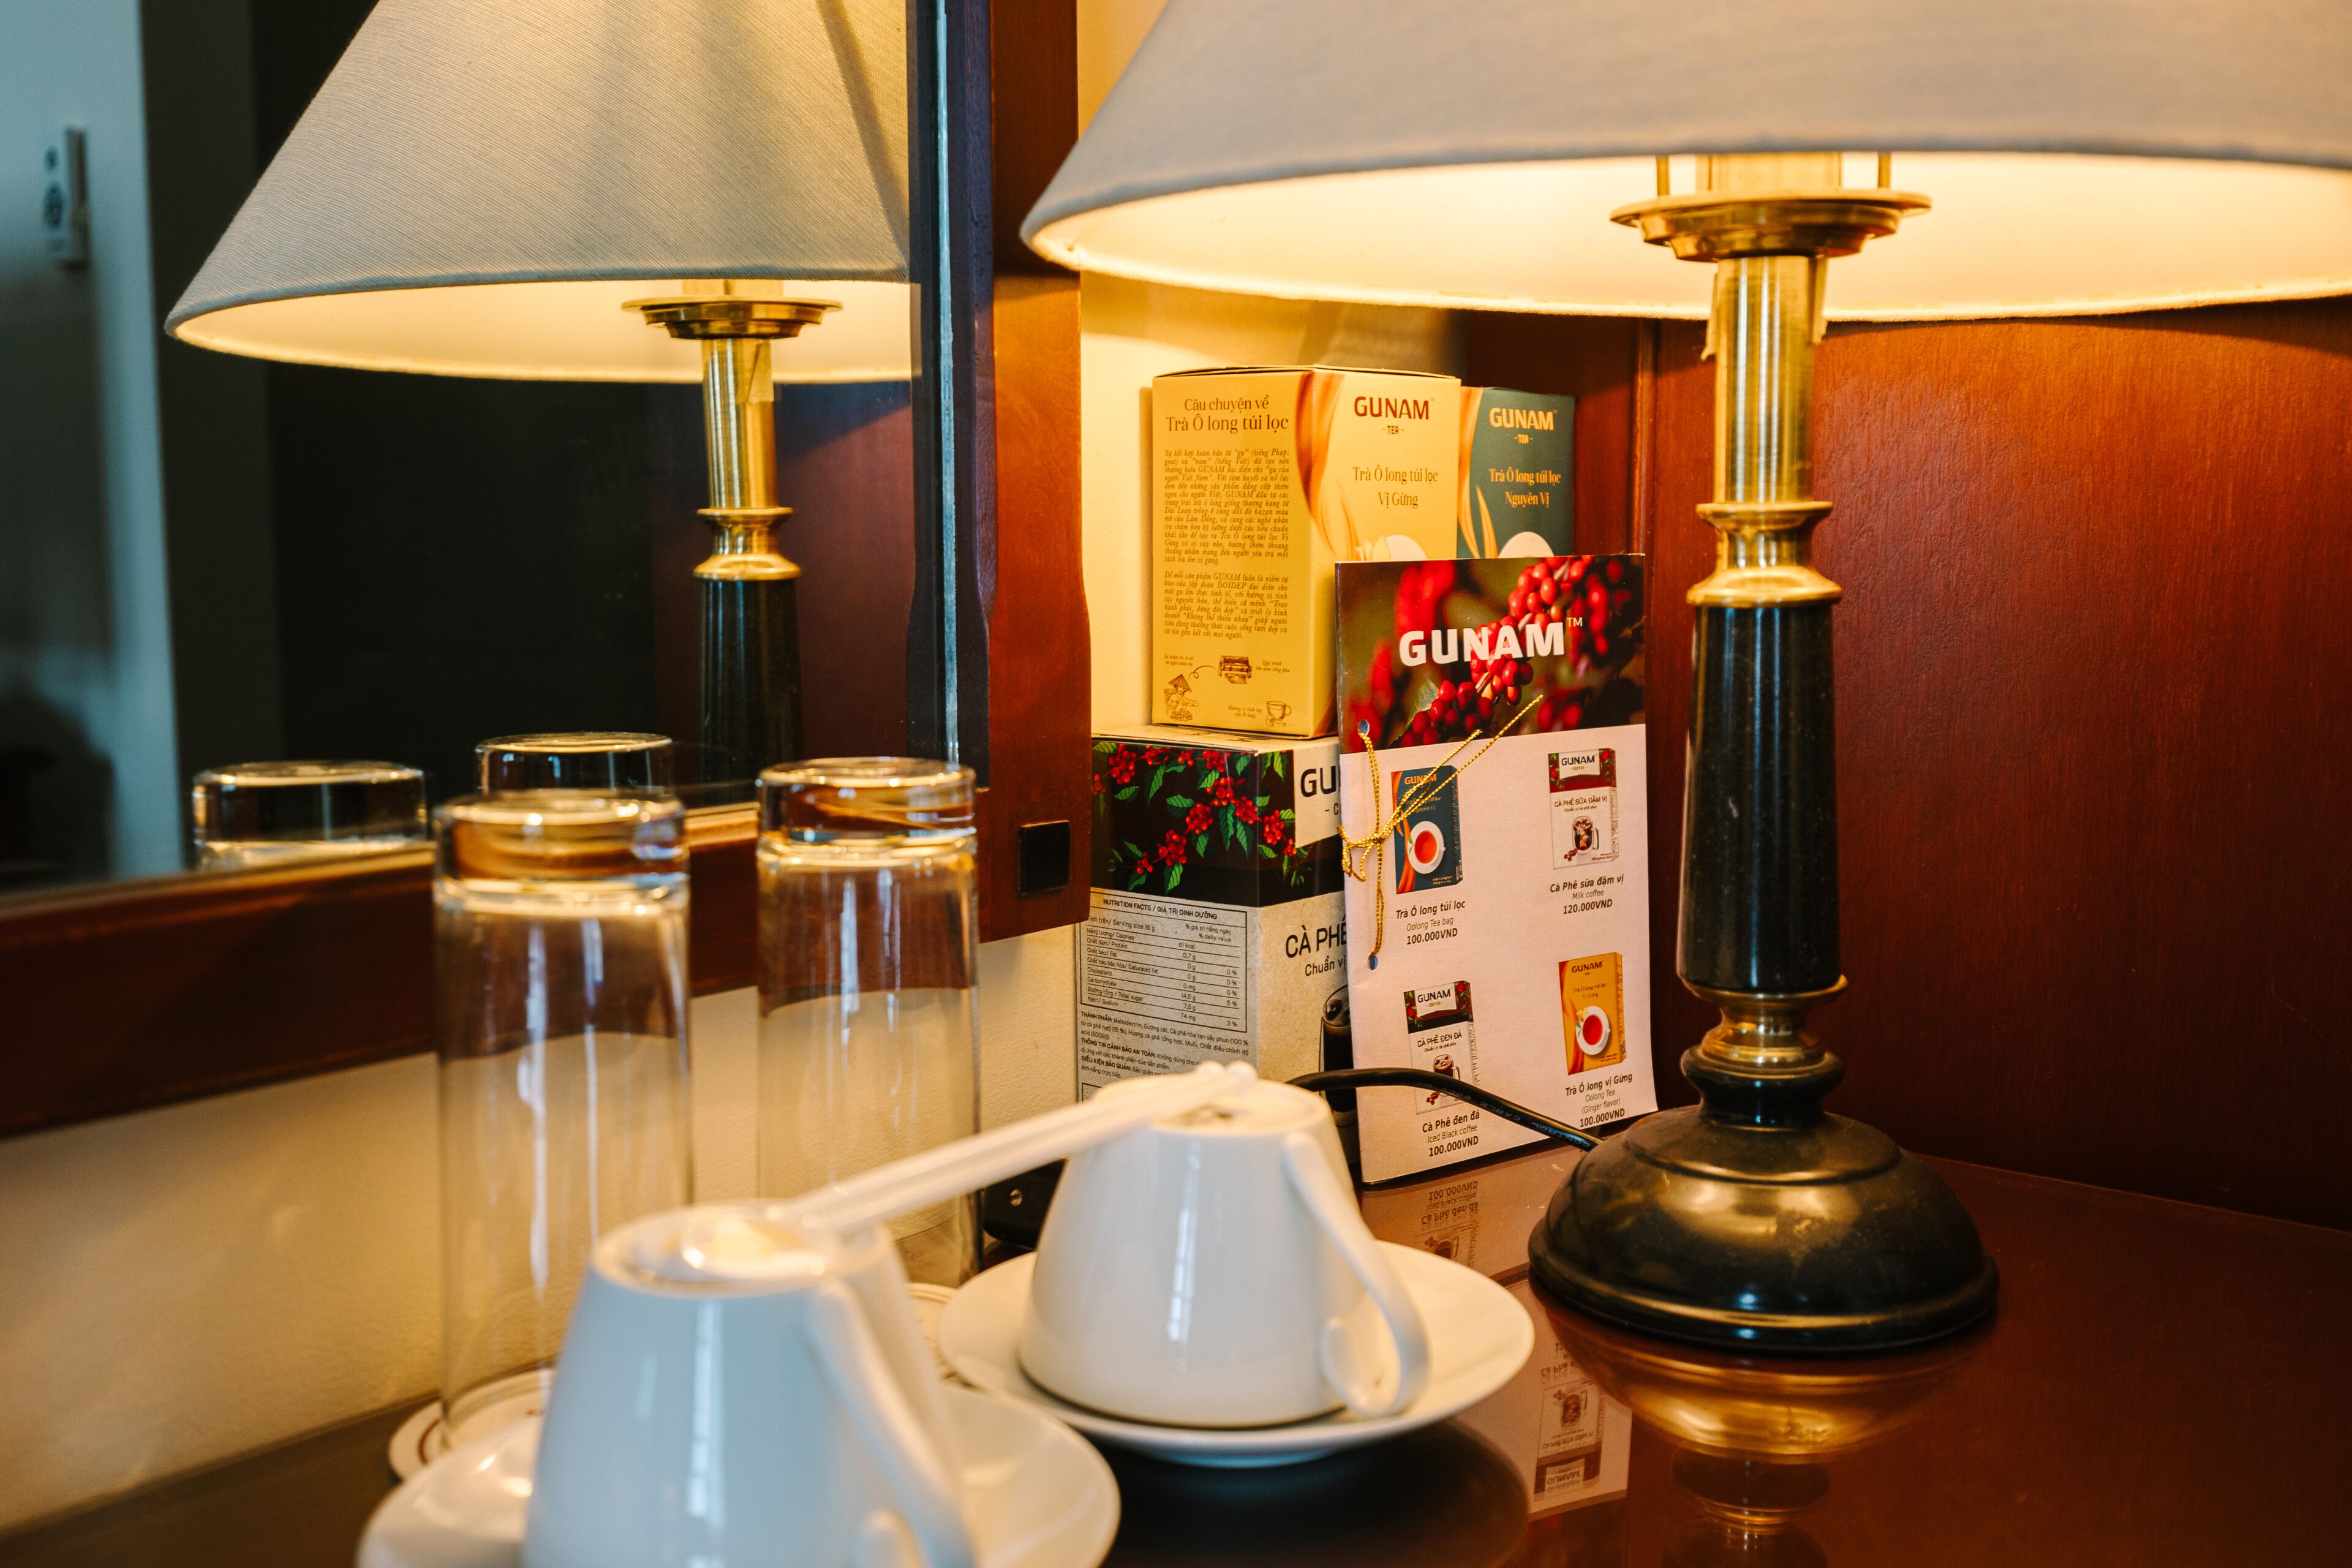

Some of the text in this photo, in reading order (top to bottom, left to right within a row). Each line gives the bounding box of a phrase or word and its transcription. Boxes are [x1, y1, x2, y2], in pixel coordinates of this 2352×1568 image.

[1185, 394, 1269, 413] Câu chuyện về
[1354, 396, 1429, 420] GUNAM
[1166, 413, 1289, 434] Trà Ô long túi lọc
[1490, 407, 1554, 431] GUNAM
[1353, 464, 1438, 484] Trà Ô long túi lọc
[1490, 467, 1561, 486] Trà Ô long túi lọc
[1378, 492, 1418, 508] Vị Gừng
[1505, 492, 1549, 508] Nguyên Vị
[1213, 572, 1240, 581] GUNAM
[1400, 622, 1565, 666] GUNAM
[1561, 755, 1595, 766] GUNAM
[1300, 764, 1341, 797] GU
[1554, 799, 1562, 807] CÀ
[1563, 797, 1574, 806] PHÊ
[1575, 796, 1587, 805] SỮA
[1550, 873, 1624, 892] Cà Phê sữa đậm vị
[1572, 889, 1605, 900] Milk coffee
[1103, 899, 1133, 908] NUTRITION
[1157, 905, 1167, 913] GIÁ
[1195, 911, 1218, 920] DƯỠNG
[1396, 900, 1466, 919] Trà Ô long túi lọc
[1563, 899, 1613, 914] 120.000VND
[1113, 920, 1132, 929] Serving
[1407, 917, 1453, 931] Oolong Tea bag
[1286, 925, 1311, 958] CÀ
[1407, 927, 1458, 944] 100.000VND
[1087, 967, 1112, 976] Cholesterol
[1128, 964, 1150, 973] Saturated
[1305, 954, 1346, 976] Chuẩn vị
[1572, 961, 1602, 973] GUNAM
[1088, 976, 1117, 986] Carbohydrate
[1417, 989, 1450, 1003] GUNAM
[1417, 1030, 1462, 1047] CÀ PHÊ ĐEN ĐÁ
[1566, 1073, 1632, 1096] Trà Ô long vị Gừng
[1585, 1088, 1615, 1102] Oolong Tea
[1581, 1098, 1621, 1115] (Ginger flavor)
[1422, 1109, 1480, 1133] Cà Phê đen đá
[1580, 1107, 1625, 1128] 100.000VND
[1428, 1125, 1477, 1144] Iced Black coffee
[1429, 1136, 1479, 1156] 100.000VND
